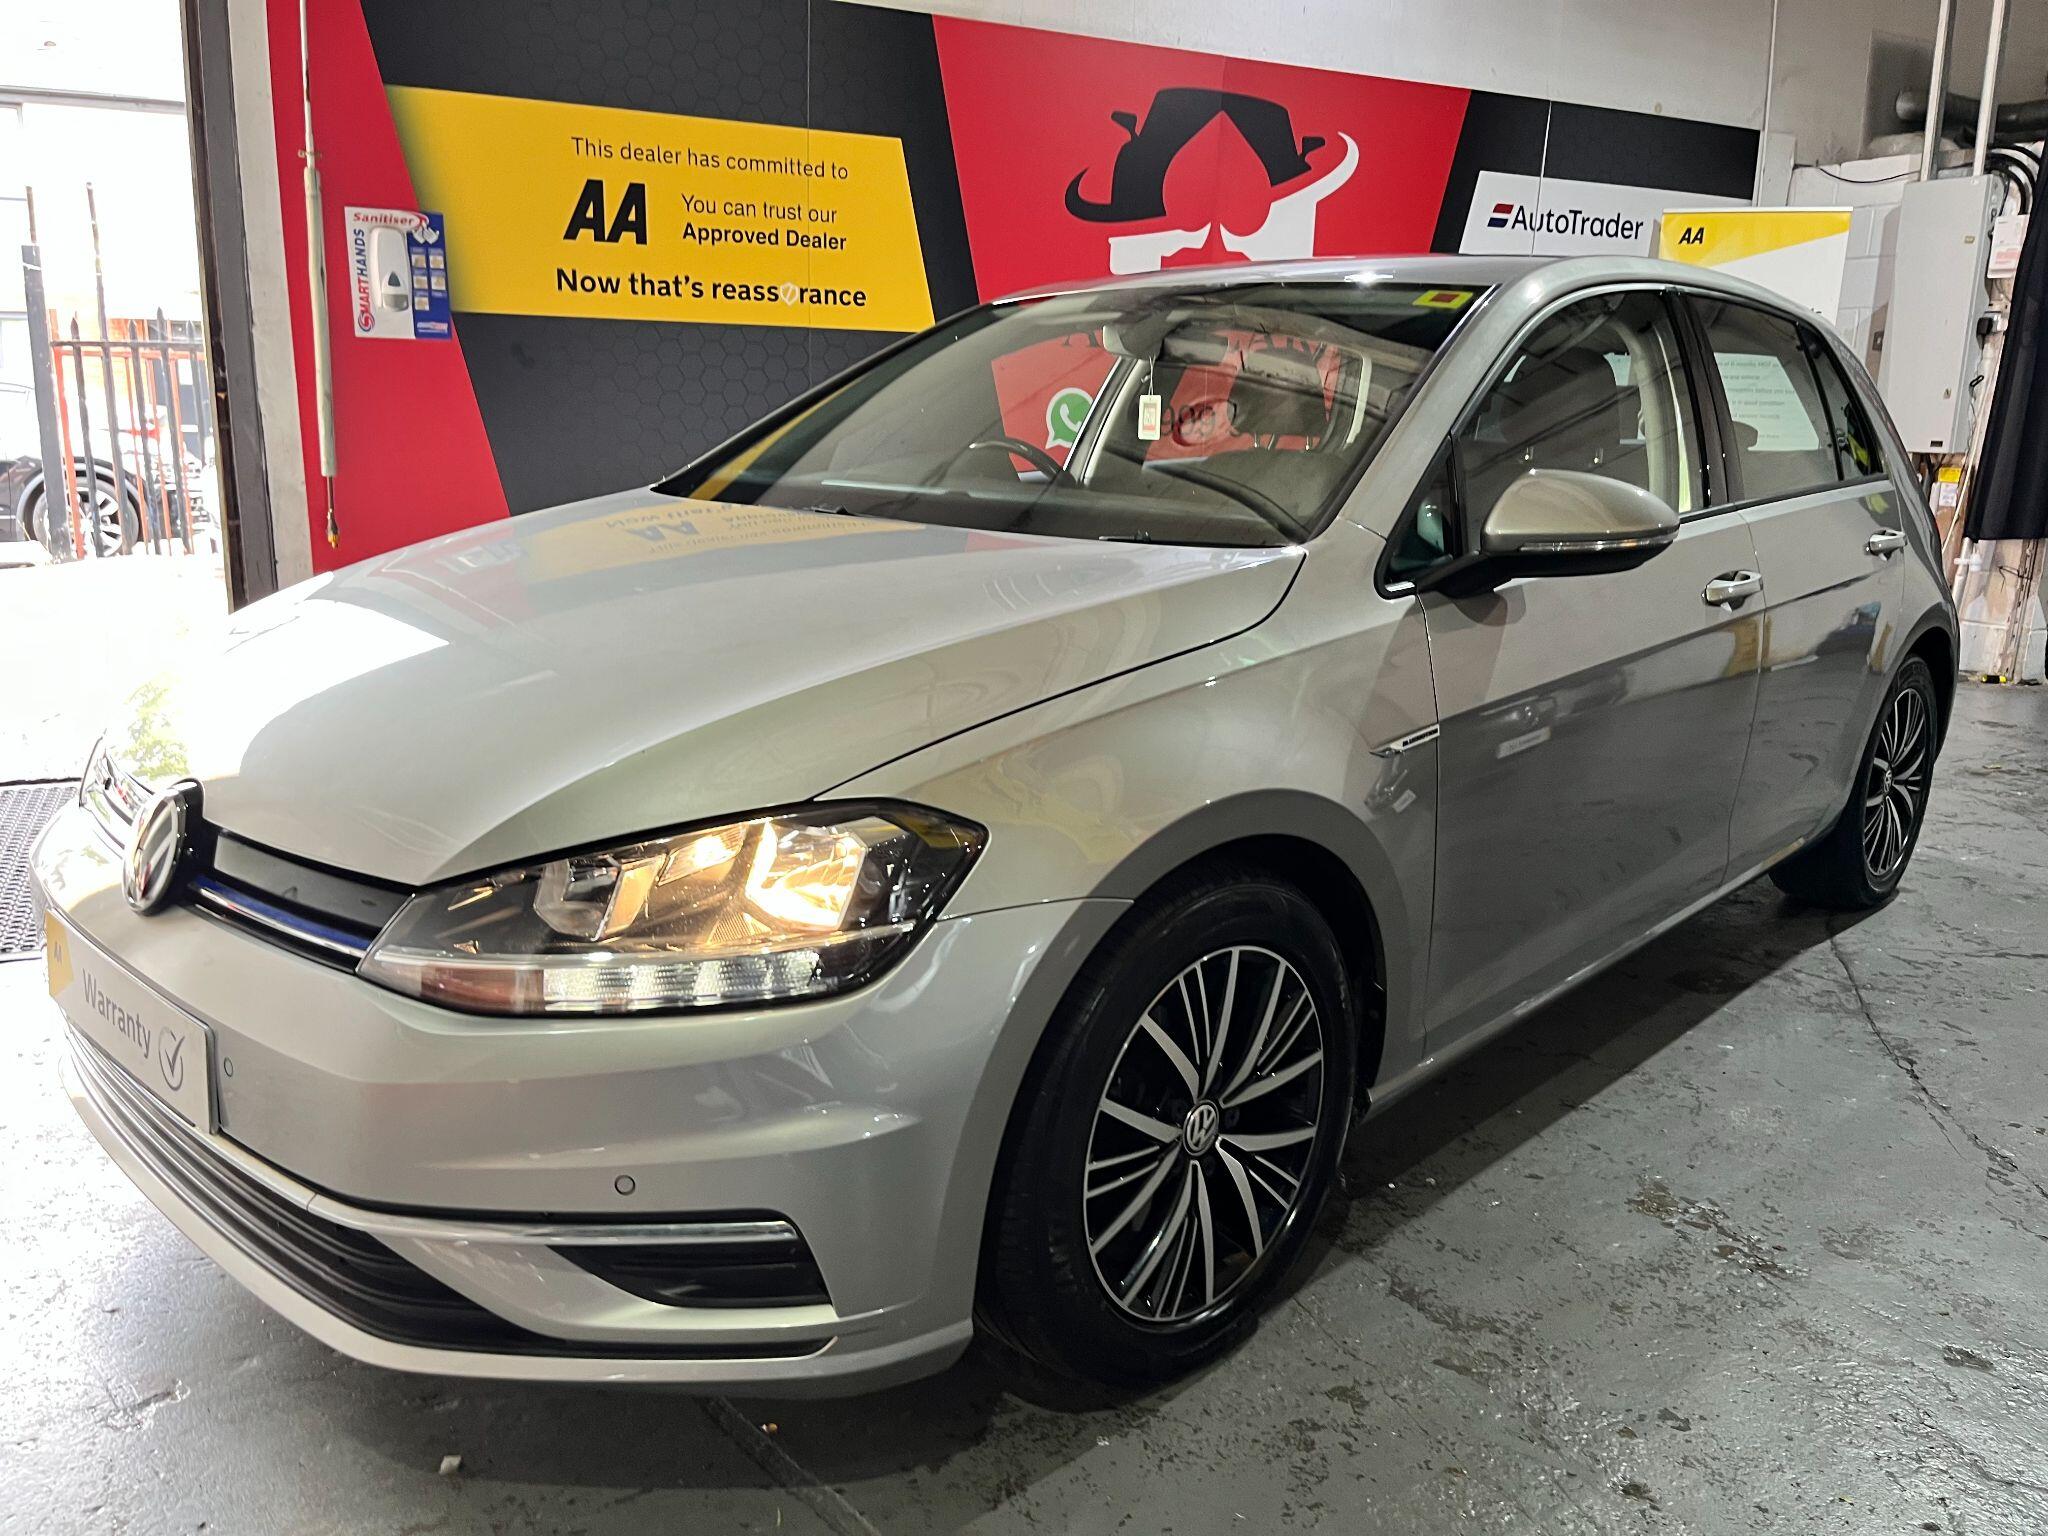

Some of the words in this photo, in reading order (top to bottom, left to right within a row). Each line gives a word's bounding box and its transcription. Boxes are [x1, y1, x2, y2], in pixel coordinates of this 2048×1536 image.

[571, 136, 613, 158] This
[620, 141, 682, 165] dealer
[687, 147, 720, 168] has
[726, 155, 826, 178] committed
[831, 162, 849, 180] to
[353, 212, 416, 226] Sanitiser
[563, 178, 648, 246] AA
[681, 193, 717, 215] You
[723, 200, 756, 218] can
[763, 201, 802, 221] trust
[808, 207, 838, 224] our
[1511, 205, 1644, 241] AutoTrader
[682, 222, 779, 246] Approved
[785, 231, 848, 251] Dealer
[1678, 226, 1705, 245] AA
[556, 267, 621, 295] Now
[628, 273, 704, 299] that's
[82, 967, 151, 1058] Warranty
